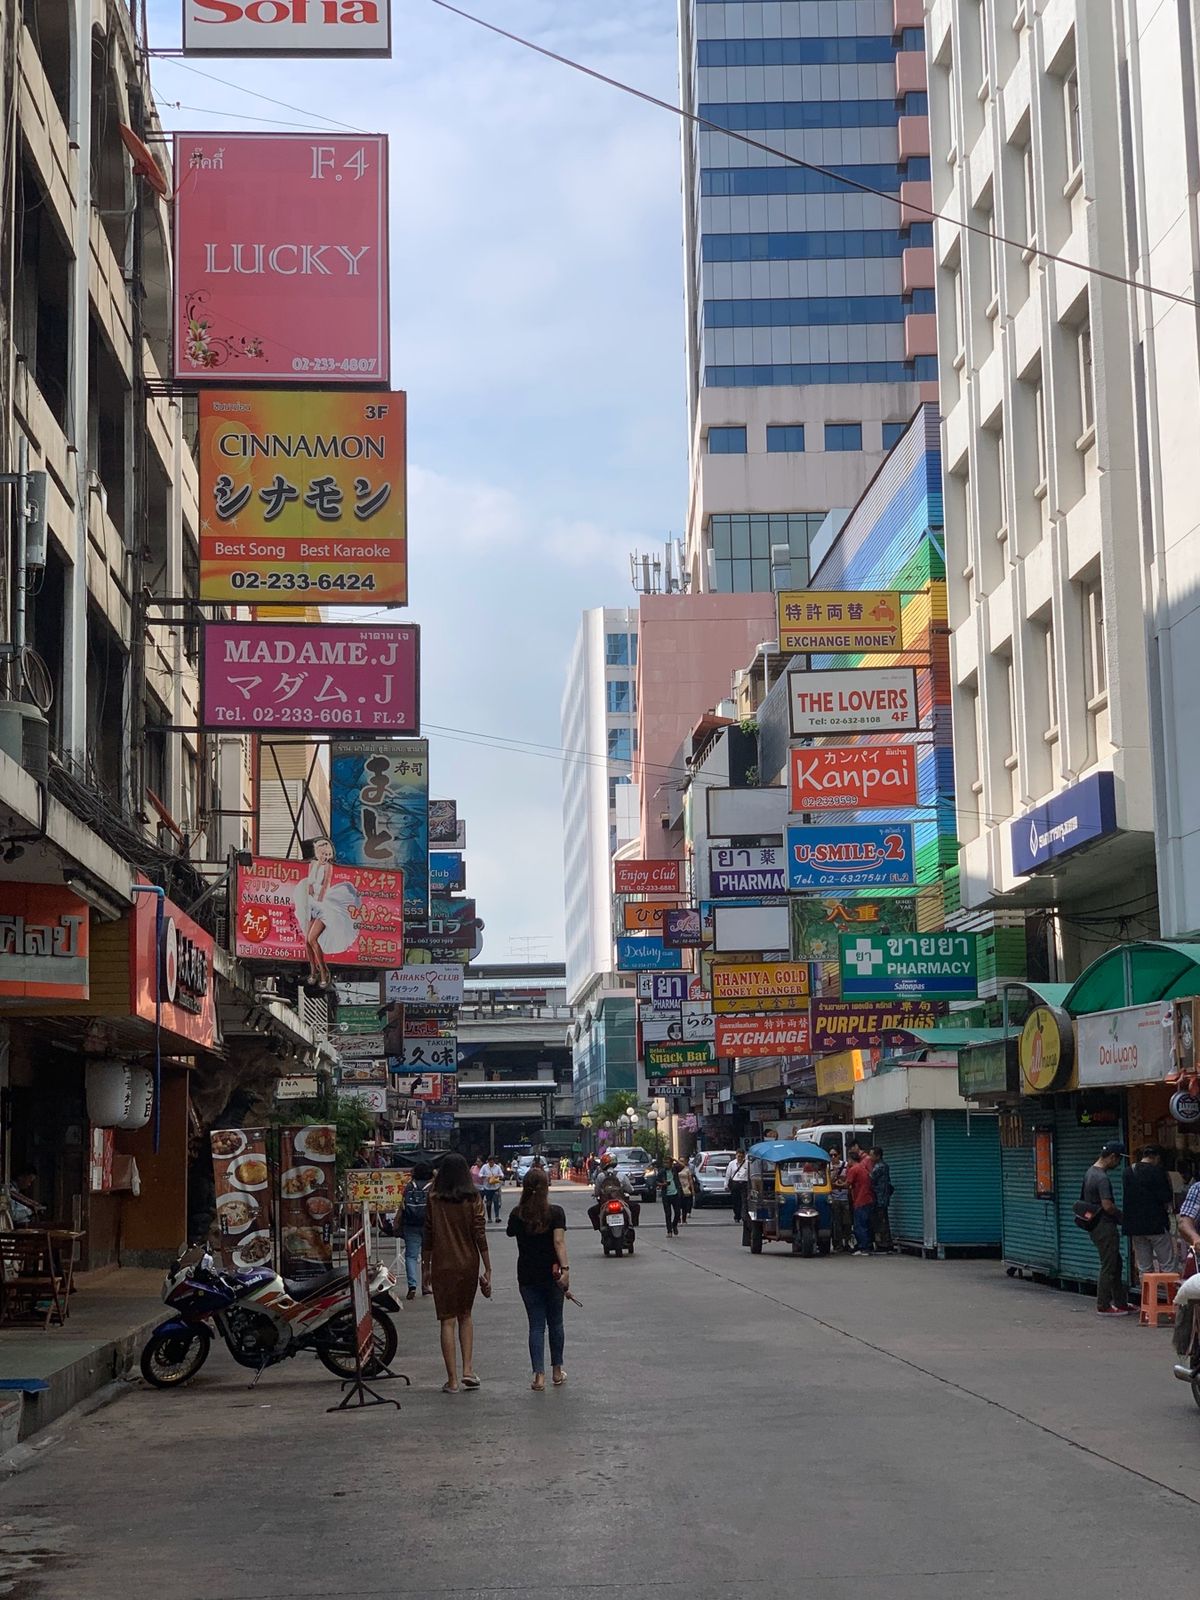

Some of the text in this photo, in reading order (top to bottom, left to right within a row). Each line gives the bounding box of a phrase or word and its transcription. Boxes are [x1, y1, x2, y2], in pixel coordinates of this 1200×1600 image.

[204, 243, 371, 276] LUCKY
[291, 357, 377, 371] 02-233-4807
[364, 404, 389, 419] 3F
[219, 434, 385, 459] CINNAMON
[213, 473, 391, 521] シナモン
[215, 542, 390, 560] Best Song Best Karaoke
[231, 572, 376, 591] 02-233-6424
[785, 602, 864, 622] 特許両替
[786, 635, 897, 648] EXCHANGE MONEY
[224, 640, 398, 666] MADAME.J
[797, 688, 909, 713] THE LOVERS
[215, 706, 245, 721] Tel.
[253, 708, 362, 723] 02-233-6061
[890, 711, 909, 722] 4F
[824, 750, 881, 765] カンパイ
[796, 758, 910, 798] Kanpai
[718, 850, 751, 868] ยา
[760, 848, 776, 865] 薬
[243, 862, 300, 884] Marilyn
[619, 866, 676, 886] Enjoy Club
[242, 894, 291, 905] SNACK BAR
[855, 951, 872, 962] ยา
[887, 938, 969, 957] ขายยา
[887, 961, 971, 975] PHARMACY
[657, 977, 682, 997] ยา
[714, 969, 807, 988] THANIYA GOLD
[894, 981, 926, 991] Salonpas
[719, 985, 803, 997] MONEY CHANGER
[815, 1015, 877, 1034] PURPLE
[721, 1030, 808, 1046] EXCHANGE
[649, 1050, 708, 1064] Snack Bar
